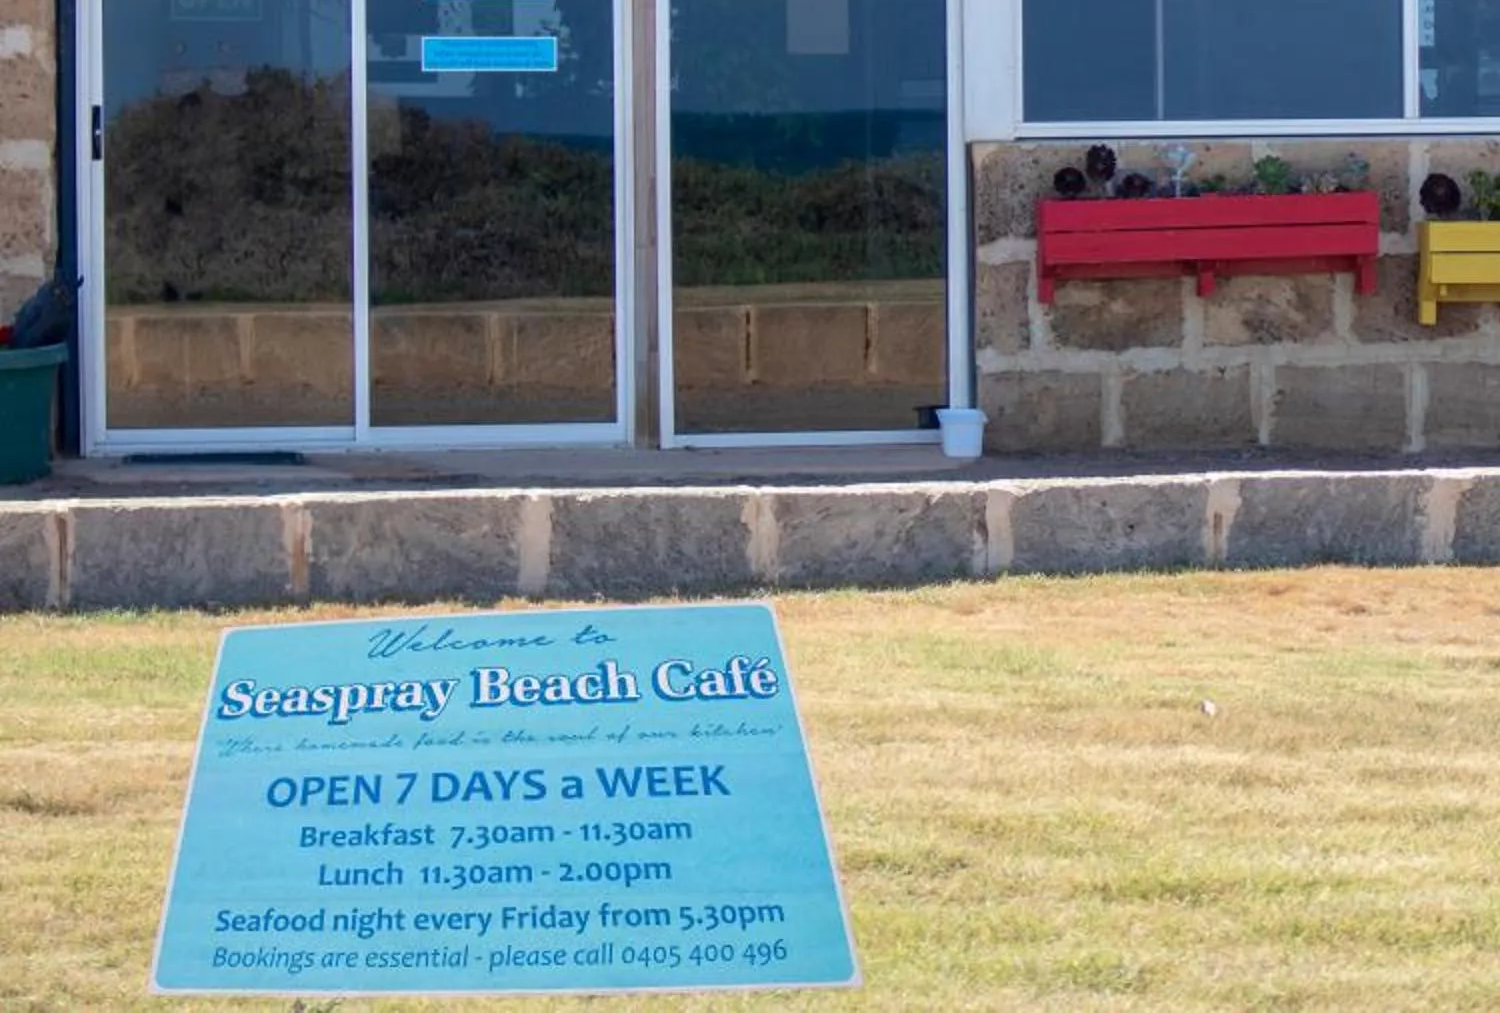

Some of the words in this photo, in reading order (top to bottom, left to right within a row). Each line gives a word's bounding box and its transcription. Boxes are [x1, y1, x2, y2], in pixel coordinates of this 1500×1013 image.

[367, 623, 554, 658] Welcome
[572, 623, 617, 645] to
[217, 678, 460, 726] Seaspray
[469, 658, 640, 707] Beach
[653, 654, 780, 701] Café
[501, 728, 536, 743] the
[606, 724, 632, 743] of
[266, 774, 382, 807] OPEN
[396, 772, 418, 805] 7
[431, 769, 548, 802] DAYS
[560, 775, 585, 799] a
[595, 765, 732, 798] WEEK
[299, 822, 436, 848] Breakfast
[450, 824, 555, 849] 7.30am
[579, 821, 693, 846] 11.30am
[318, 861, 404, 886] Lunch
[419, 863, 533, 889] 11.30am
[559, 860, 673, 887] 2.00pm
[215, 907, 326, 932] Seafood
[332, 907, 406, 938] night
[413, 911, 493, 936] every
[501, 905, 590, 934] Friday
[600, 903, 671, 927] from
[679, 903, 785, 931] 5.30pm
[212, 946, 315, 973] Bookings
[321, 950, 360, 968] are
[365, 944, 469, 968] essential
[489, 944, 566, 972] please
[573, 942, 614, 966] call
[621, 944, 682, 968] 0405
[689, 944, 735, 967] 400
[742, 939, 788, 966] 496
